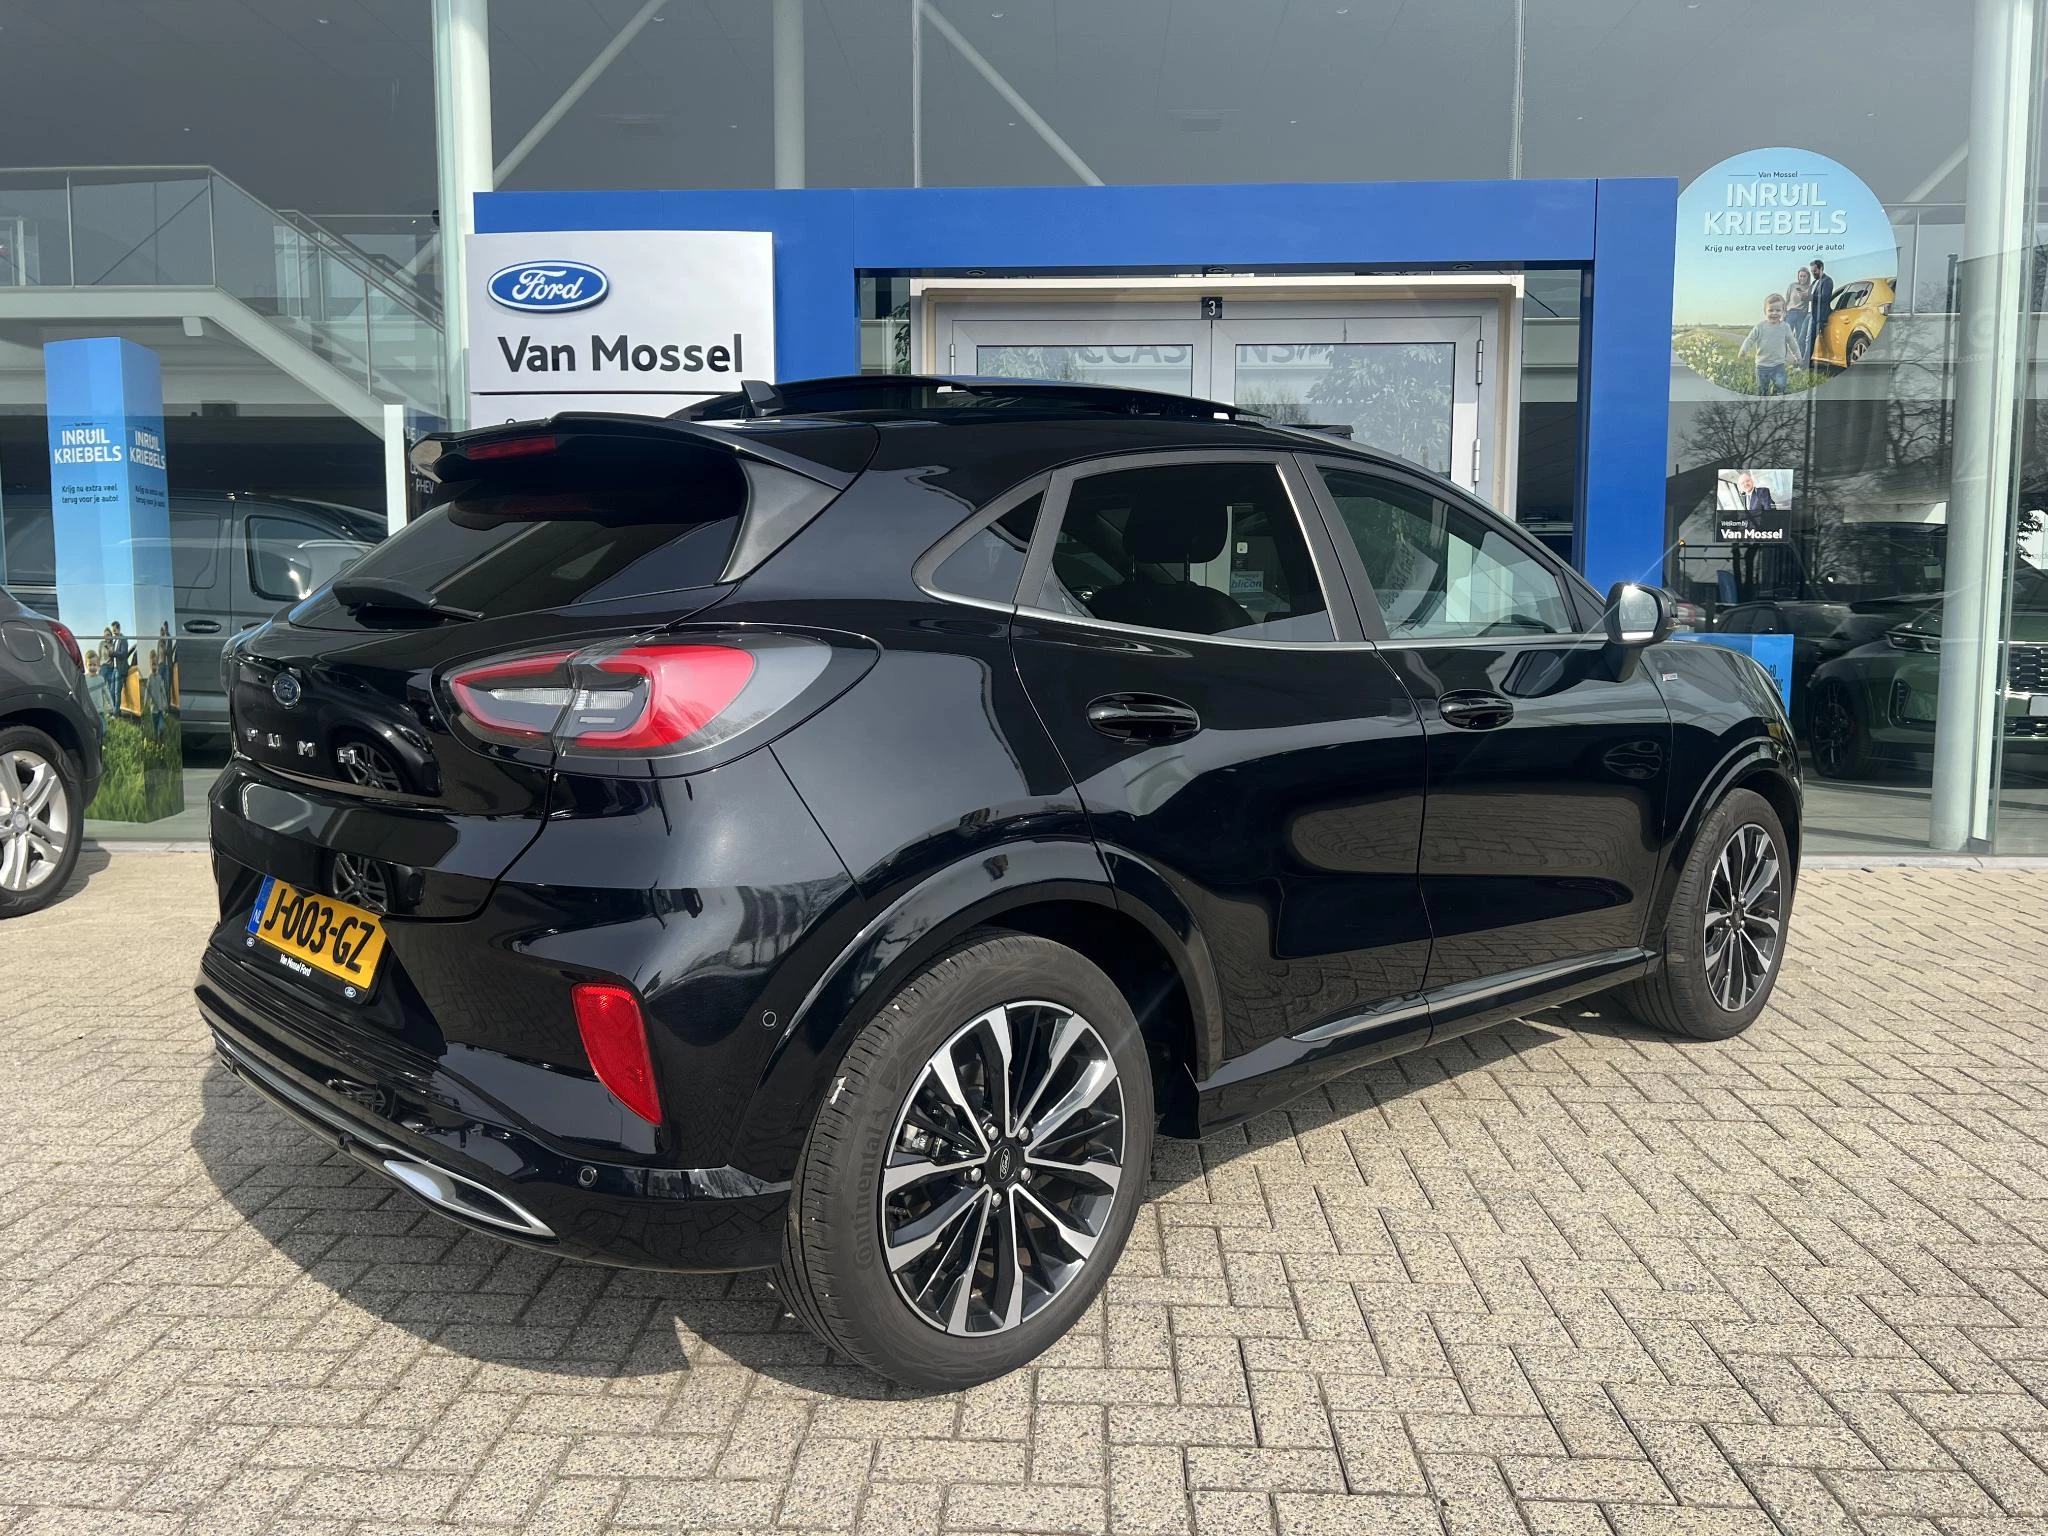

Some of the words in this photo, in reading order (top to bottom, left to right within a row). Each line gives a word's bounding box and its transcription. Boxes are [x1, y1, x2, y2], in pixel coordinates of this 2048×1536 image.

[1727, 182, 1828, 207] INRUIL
[1703, 209, 1848, 235] KRIEBELS
[1704, 244, 1723, 253] Krijg
[1735, 244, 1756, 252] extra
[1775, 244, 1795, 253] terug
[1816, 244, 1824, 252] je
[1825, 243, 1845, 251] auto!
[511, 269, 584, 301] Ford
[1208, 300, 1216, 316] 3
[497, 335, 576, 373] Van
[591, 333, 743, 373] Mossel
[62, 428, 111, 446] INRUIL
[134, 430, 161, 452] INRUIL
[54, 445, 122, 465] KRIEBELS
[129, 446, 167, 470] KRIEBELS
[103, 483, 118, 491] veel
[415, 478, 435, 494] PHEV
[61, 496, 78, 505] terug
[1720, 528, 1742, 539] Van
[1744, 528, 1783, 539] Mossel
[263, 888, 376, 974] J-003-GZ
[854, 1126, 885, 1272] Continental
